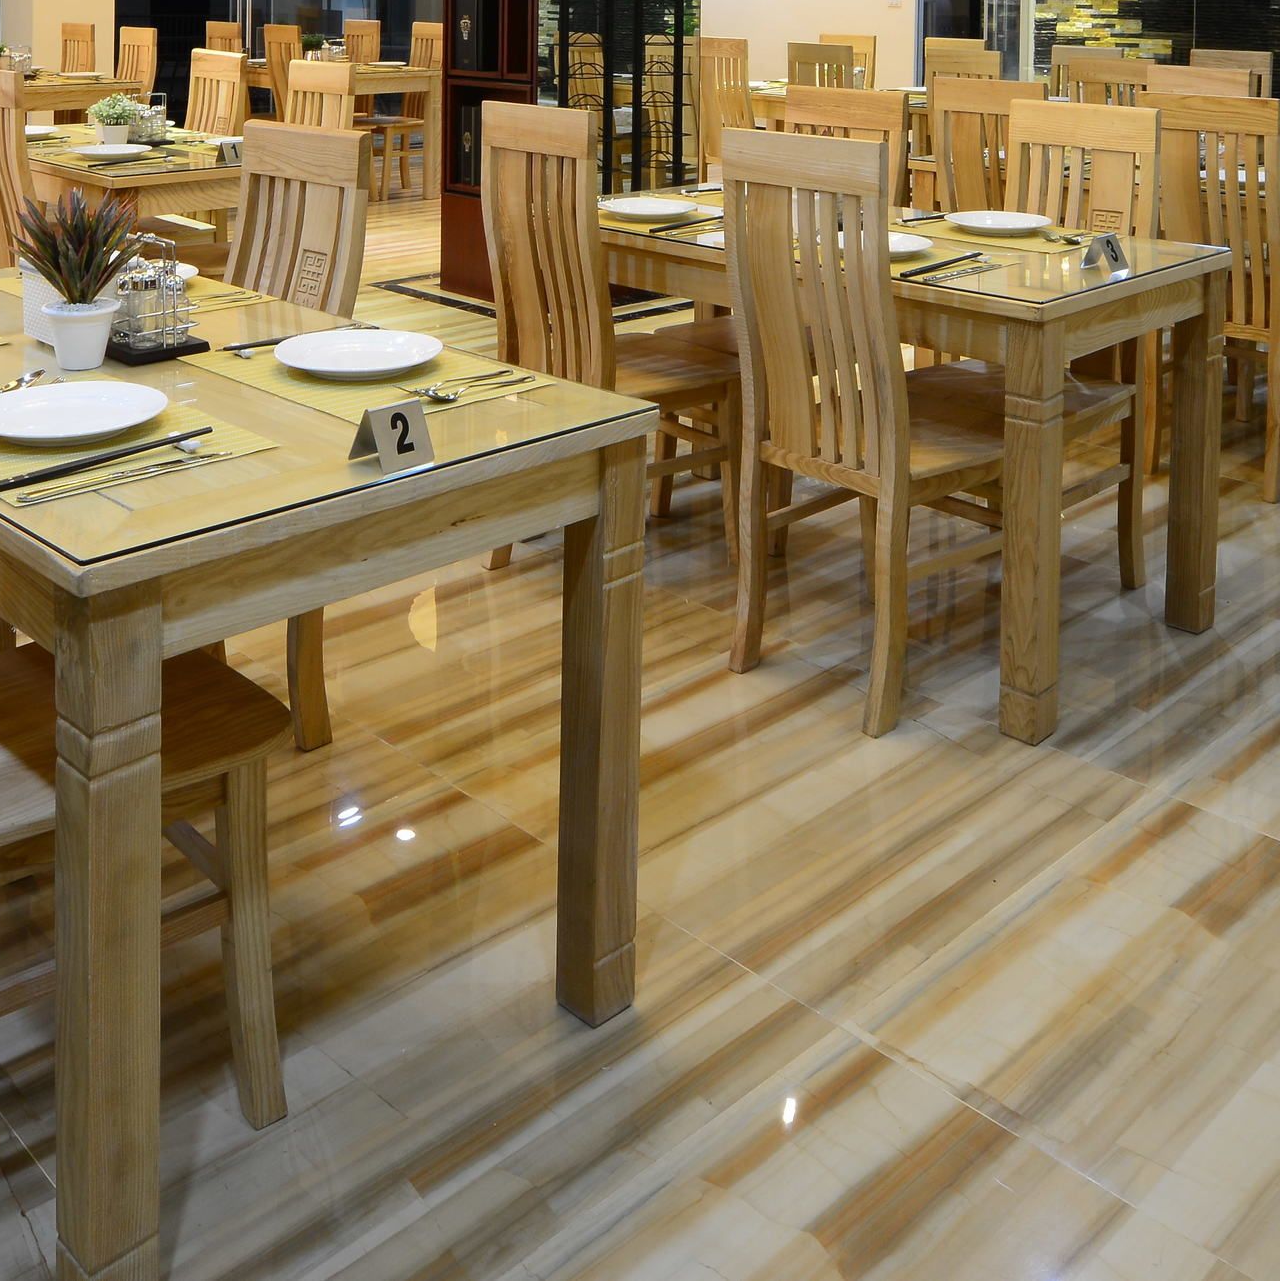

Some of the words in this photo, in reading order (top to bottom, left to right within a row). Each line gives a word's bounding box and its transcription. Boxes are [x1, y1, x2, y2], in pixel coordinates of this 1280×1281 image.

[230, 143, 239, 158] 1
[1105, 239, 1119, 262] 3
[390, 412, 415, 455] 2
